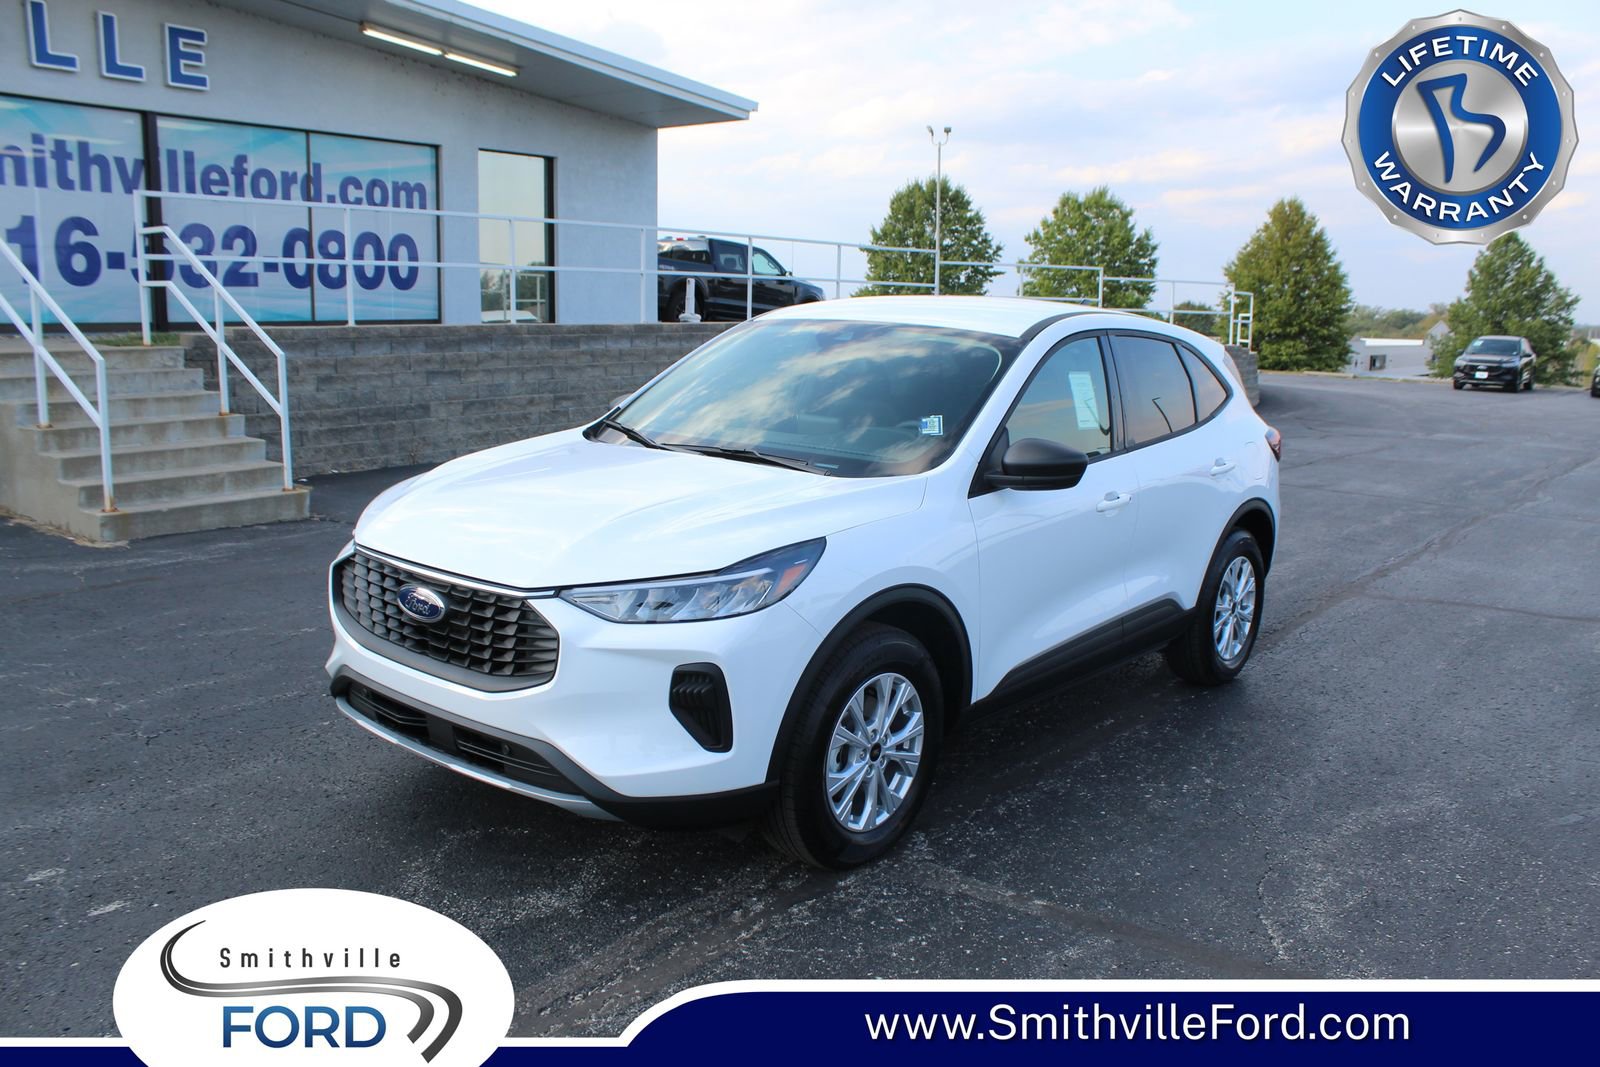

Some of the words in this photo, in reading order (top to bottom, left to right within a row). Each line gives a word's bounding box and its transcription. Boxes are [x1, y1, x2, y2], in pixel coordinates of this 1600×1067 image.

[27, 0, 210, 91] LLE
[0, 132, 427, 210] ithvlleford.com
[404, 592, 431, 615] Ford
